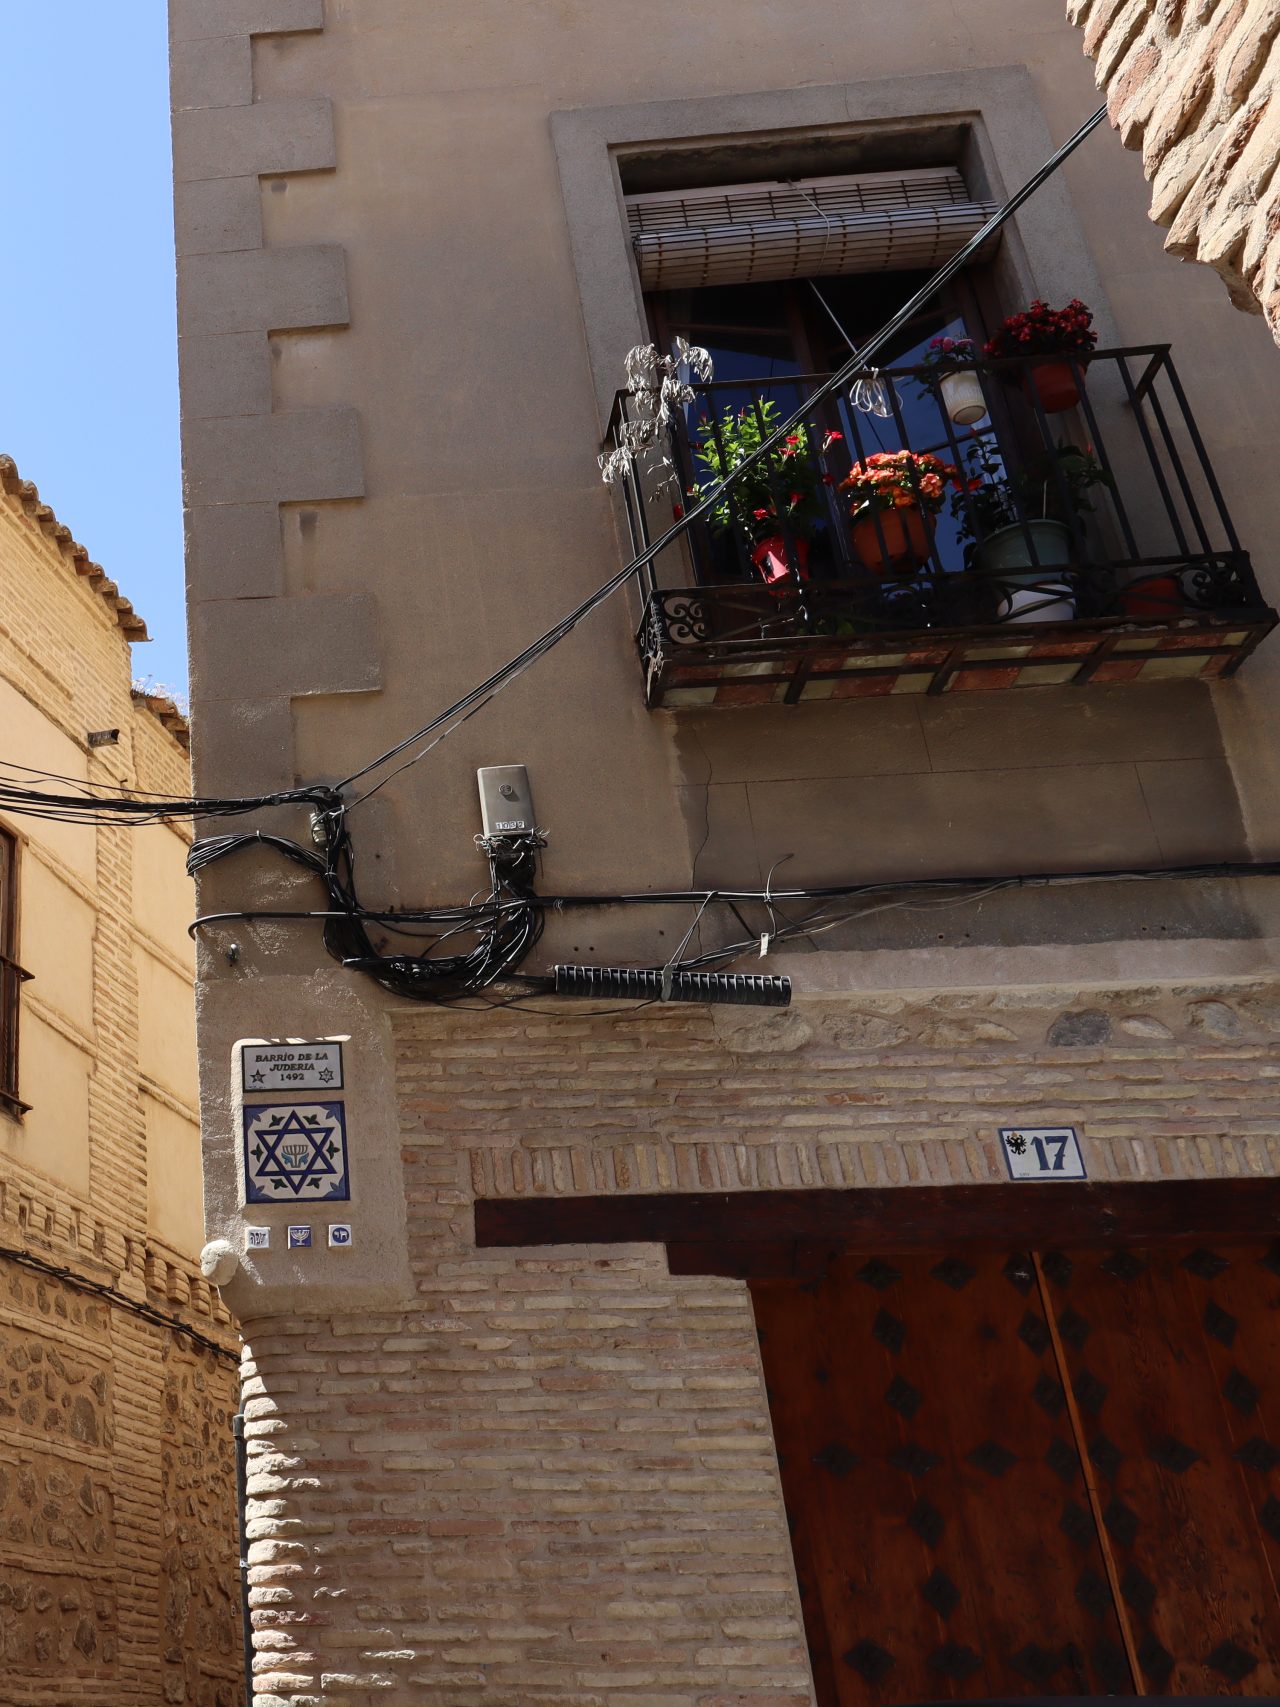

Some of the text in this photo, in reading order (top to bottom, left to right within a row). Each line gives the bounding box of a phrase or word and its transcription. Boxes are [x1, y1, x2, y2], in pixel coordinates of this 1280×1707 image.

[297, 1053, 312, 1061] DE
[314, 1052, 329, 1061] LA
[280, 1073, 304, 1081] 1492
[1030, 1136, 1069, 1170] 17
